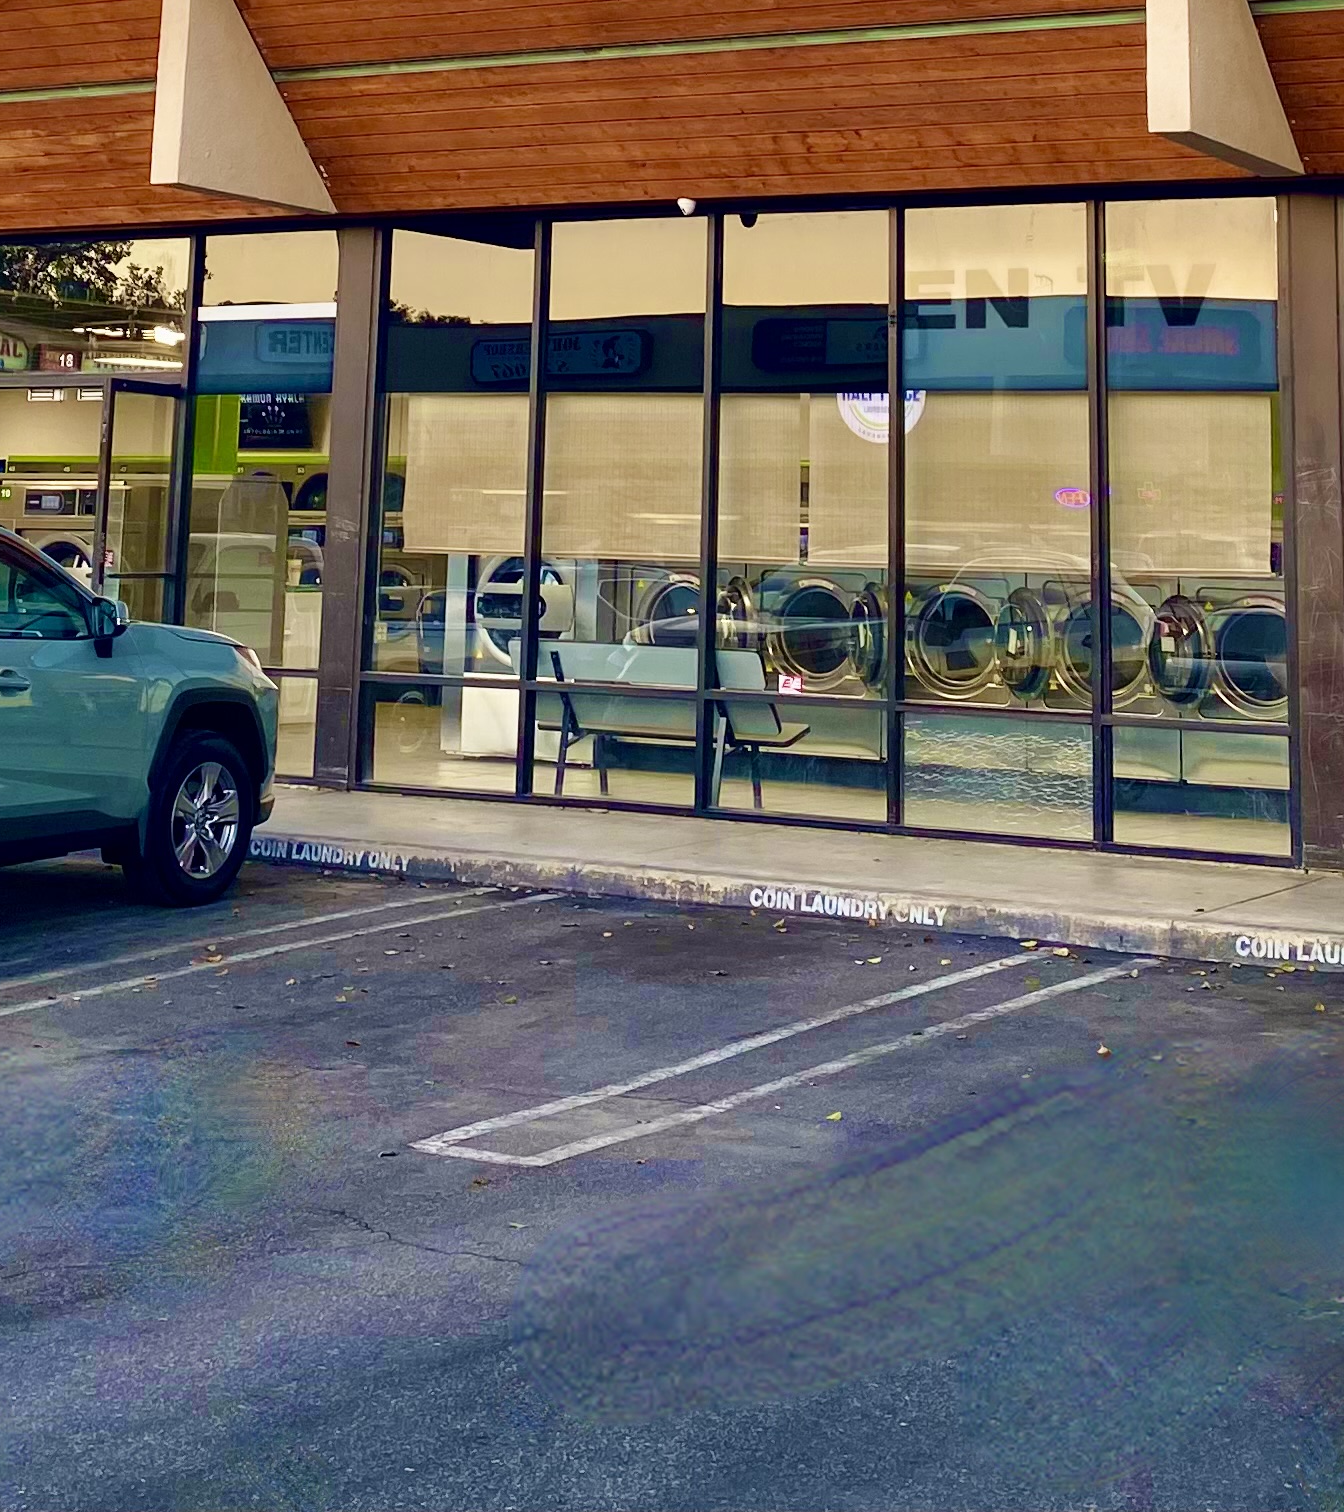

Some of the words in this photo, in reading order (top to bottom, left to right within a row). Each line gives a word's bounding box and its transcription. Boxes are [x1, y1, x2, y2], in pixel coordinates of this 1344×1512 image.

[59, 353, 74, 368] 18
[250, 839, 288, 859] COIN
[291, 842, 365, 868] LAUNDRY
[367, 849, 410, 872] ONLY
[749, 888, 795, 911] COIN
[800, 890, 890, 920] LAUNDRY
[1235, 935, 1291, 960] COIN
